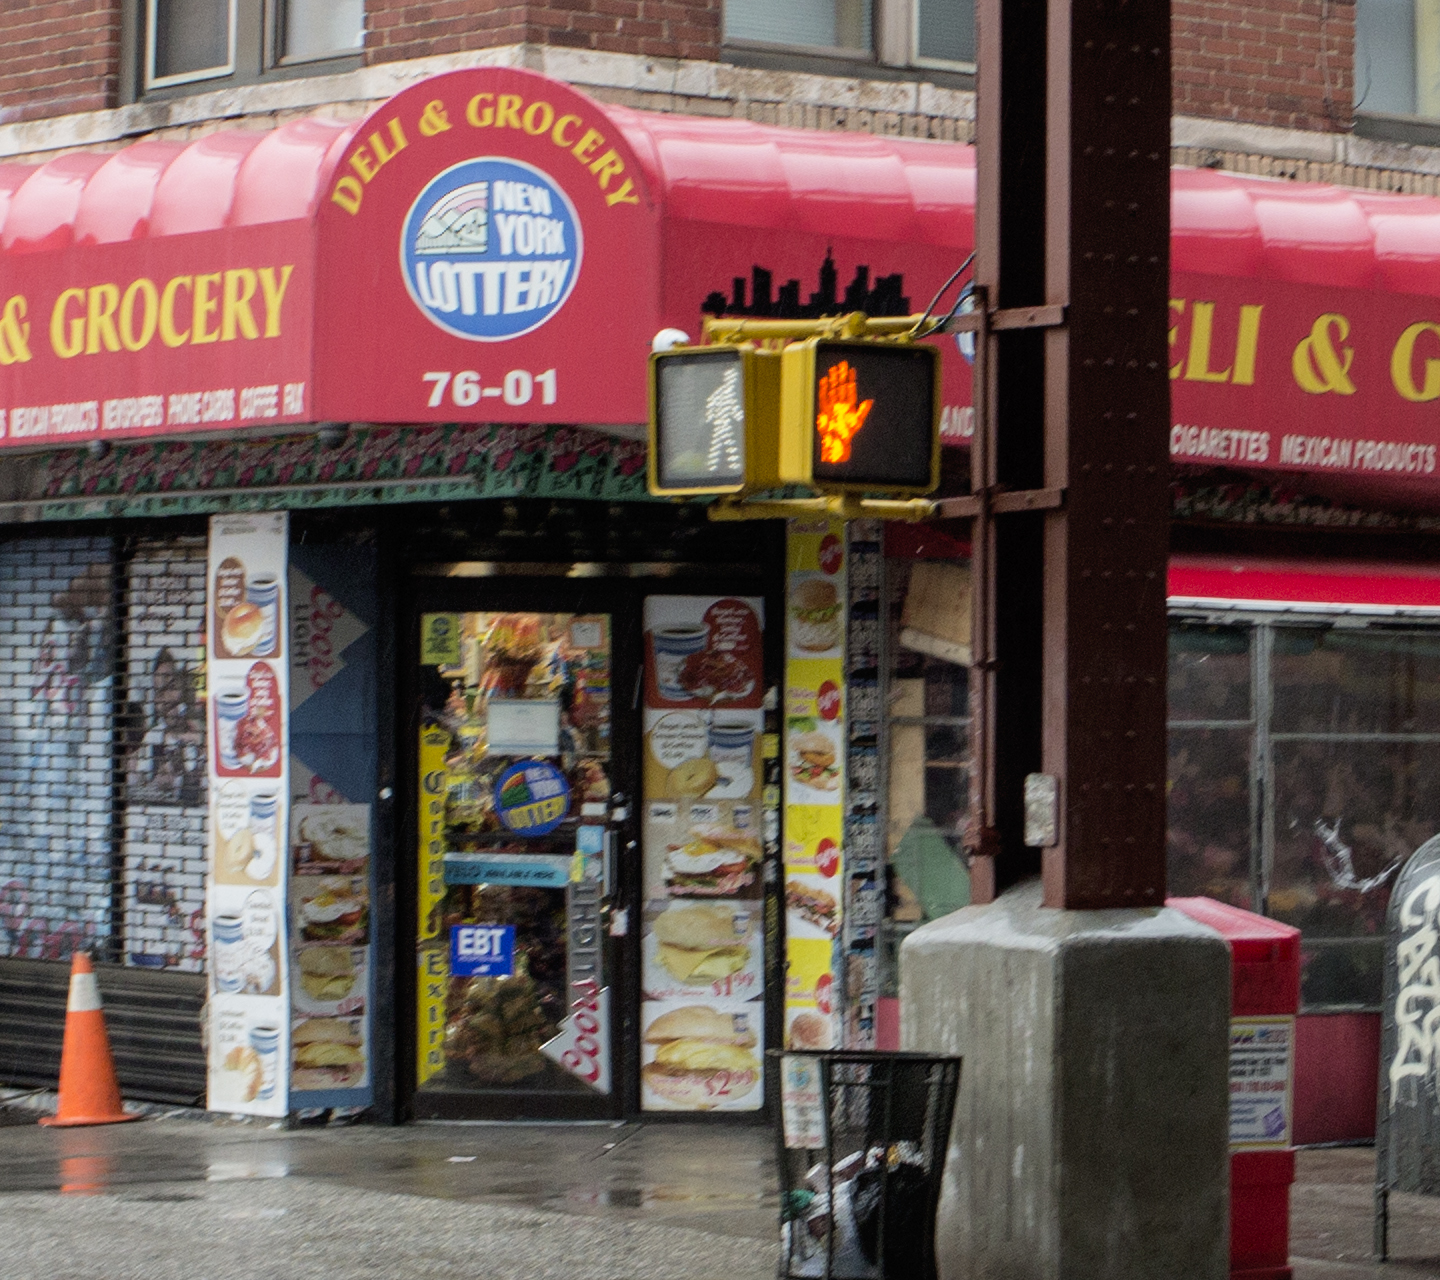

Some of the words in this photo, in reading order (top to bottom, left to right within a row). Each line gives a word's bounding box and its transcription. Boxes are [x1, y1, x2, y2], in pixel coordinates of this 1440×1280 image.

[331, 116, 410, 216] DELI
[418, 99, 453, 137] &
[466, 92, 641, 208] GROCERY
[492, 180, 553, 215] NEW
[494, 213, 567, 256] YORK
[50, 263, 296, 361] GROCERY
[415, 259, 572, 317] LOTTERY
[1291, 313, 1359, 396] &
[423, 368, 558, 408] 76-01
[1170, 424, 1270, 463] CIGARETTES
[1281, 434, 1352, 469] MEXICAN
[1354, 440, 1436, 475] PRODUCTS
[456, 927, 507, 956] EBT
